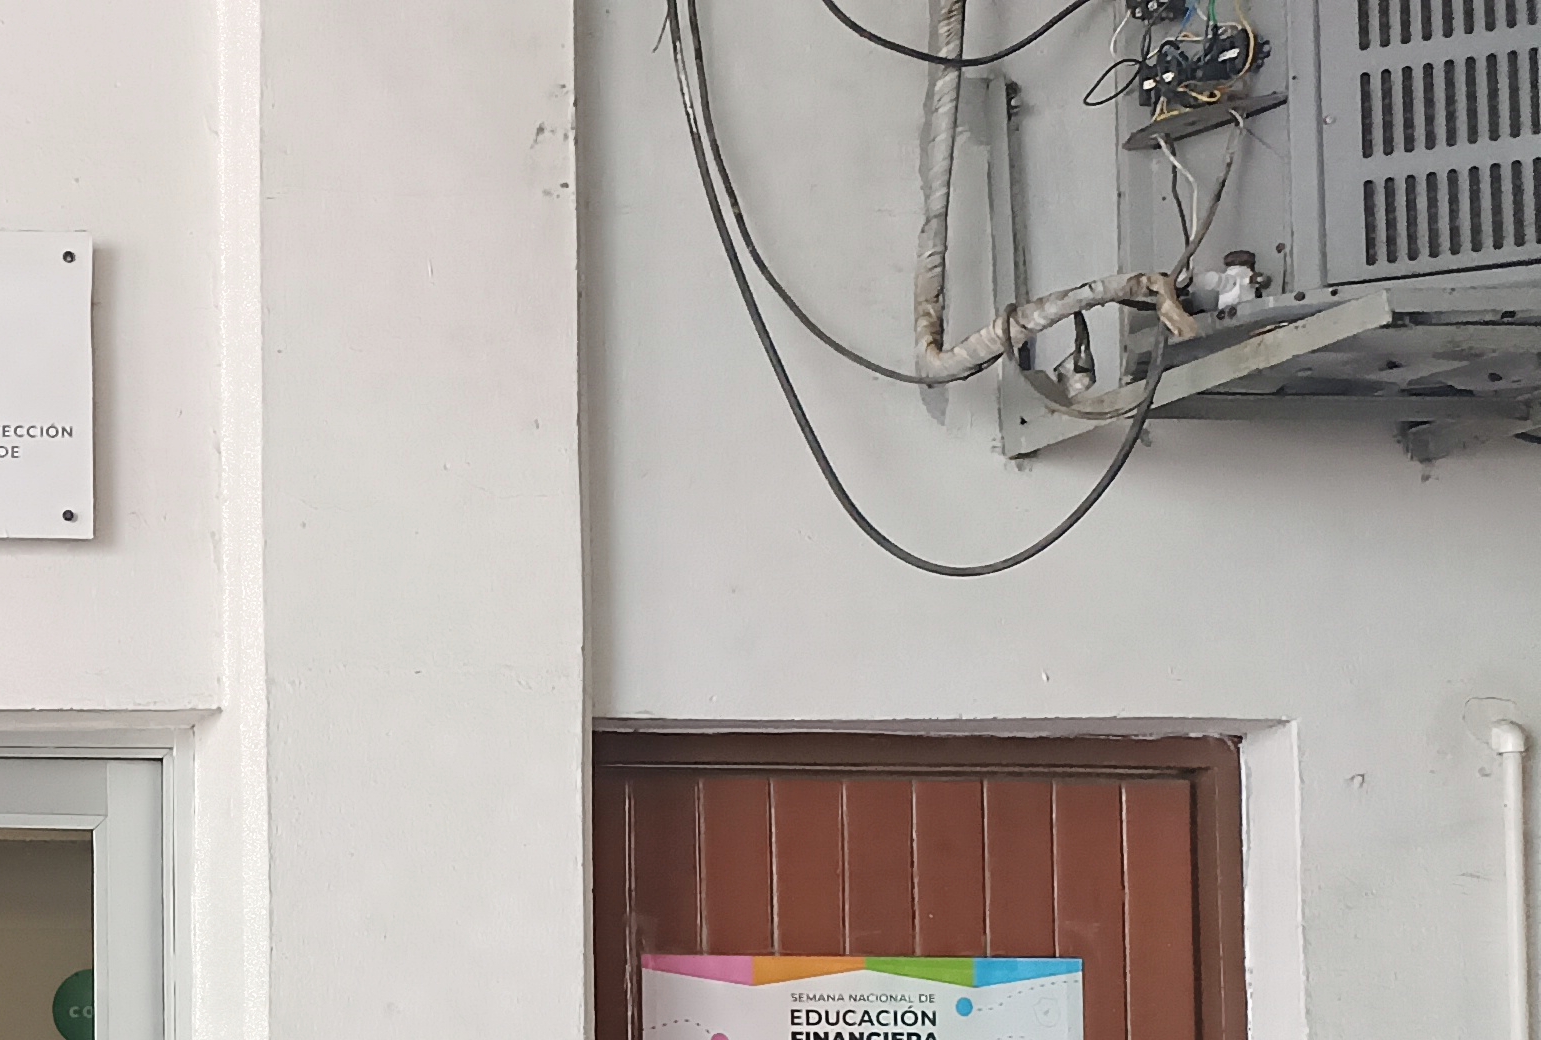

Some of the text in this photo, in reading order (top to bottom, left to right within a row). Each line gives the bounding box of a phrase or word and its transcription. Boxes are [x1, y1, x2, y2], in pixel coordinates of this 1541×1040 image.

[791, 993, 935, 1003] SEMANA NACIONAL DE
[791, 1005, 936, 1026] EDUCACIÓN
